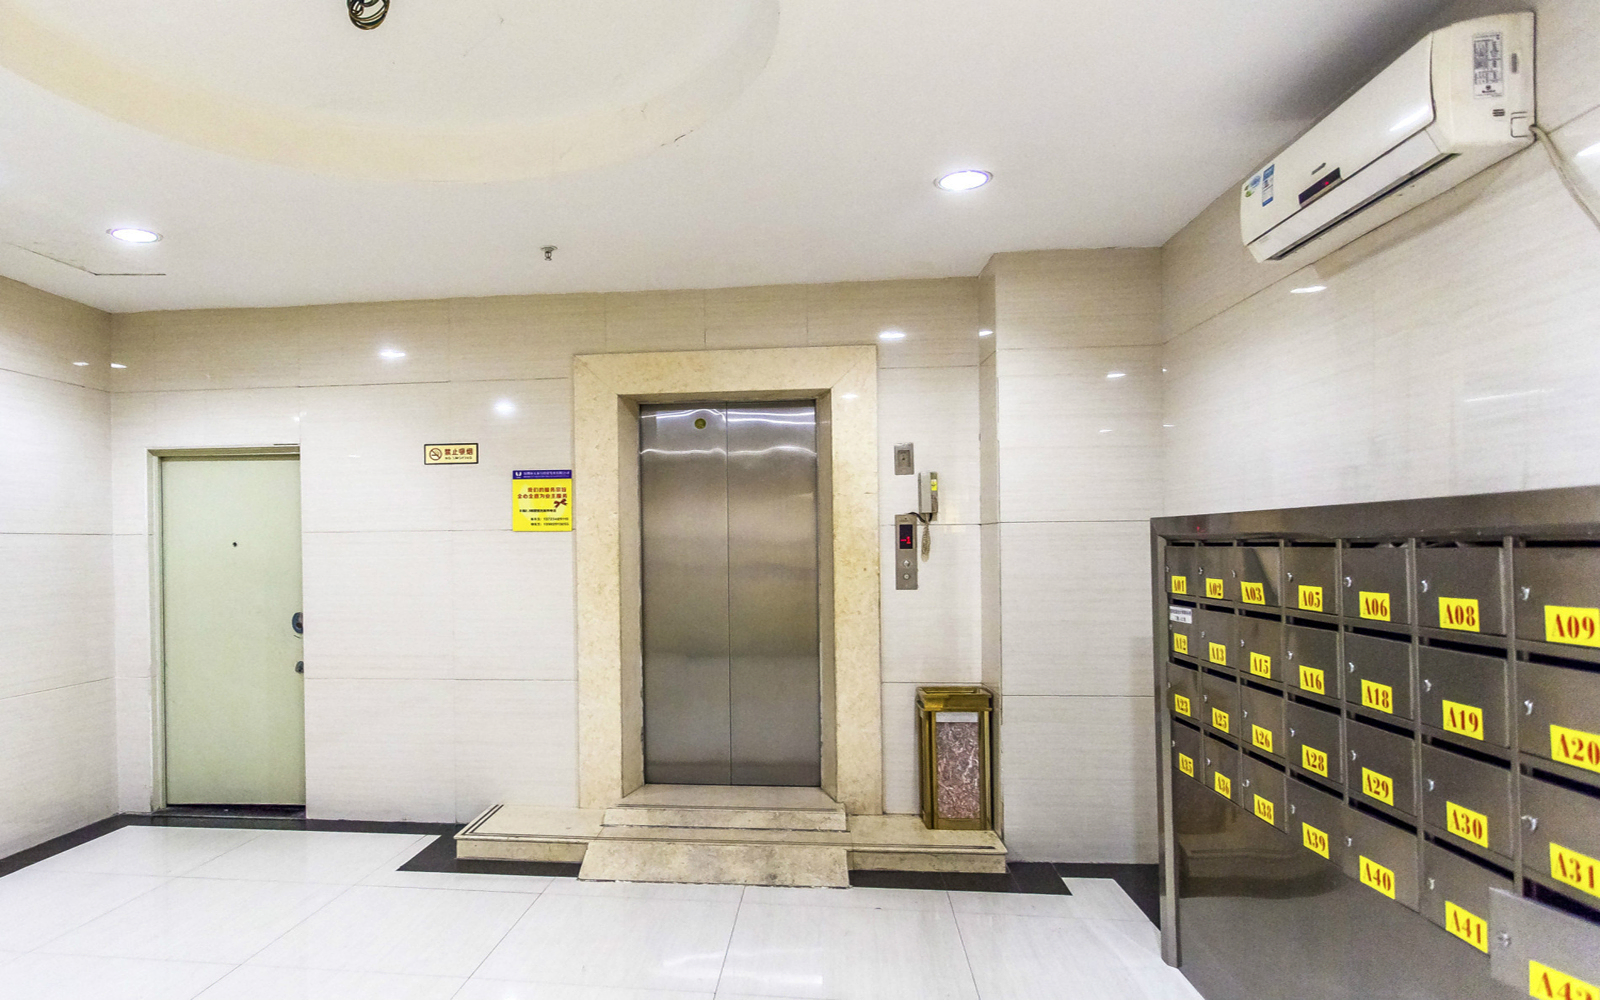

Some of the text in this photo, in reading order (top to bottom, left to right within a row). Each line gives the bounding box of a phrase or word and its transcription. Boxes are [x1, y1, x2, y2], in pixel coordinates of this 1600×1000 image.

[1173, 579, 1185, 592] A01
[1209, 582, 1222, 597] A02
[1243, 586, 1263, 602] A03
[1301, 590, 1321, 608] A05
[1363, 597, 1388, 617] A06
[1444, 603, 1476, 627] A08
[1553, 613, 1595, 639] A09
[1175, 636, 1187, 652] A12
[1211, 647, 1225, 662] A13
[1253, 657, 1269, 675] A15
[1302, 670, 1323, 691] A16
[1176, 697, 1189, 713] A23
[1365, 685, 1390, 709] A18
[1214, 711, 1227, 729] A25
[1447, 706, 1479, 733] A19
[1255, 729, 1271, 748] A26
[1557, 733, 1600, 766] A20
[1181, 757, 1192, 774] A35
[1304, 749, 1325, 772] A28
[1217, 776, 1229, 795] A36
[1365, 773, 1390, 799] A29
[1257, 799, 1272, 820] A38
[1450, 809, 1483, 840] A30
[1305, 829, 1326, 852] A39
[1364, 862, 1392, 892] A40
[1556, 852, 1595, 889] A31
[1452, 910, 1482, 944] A41
